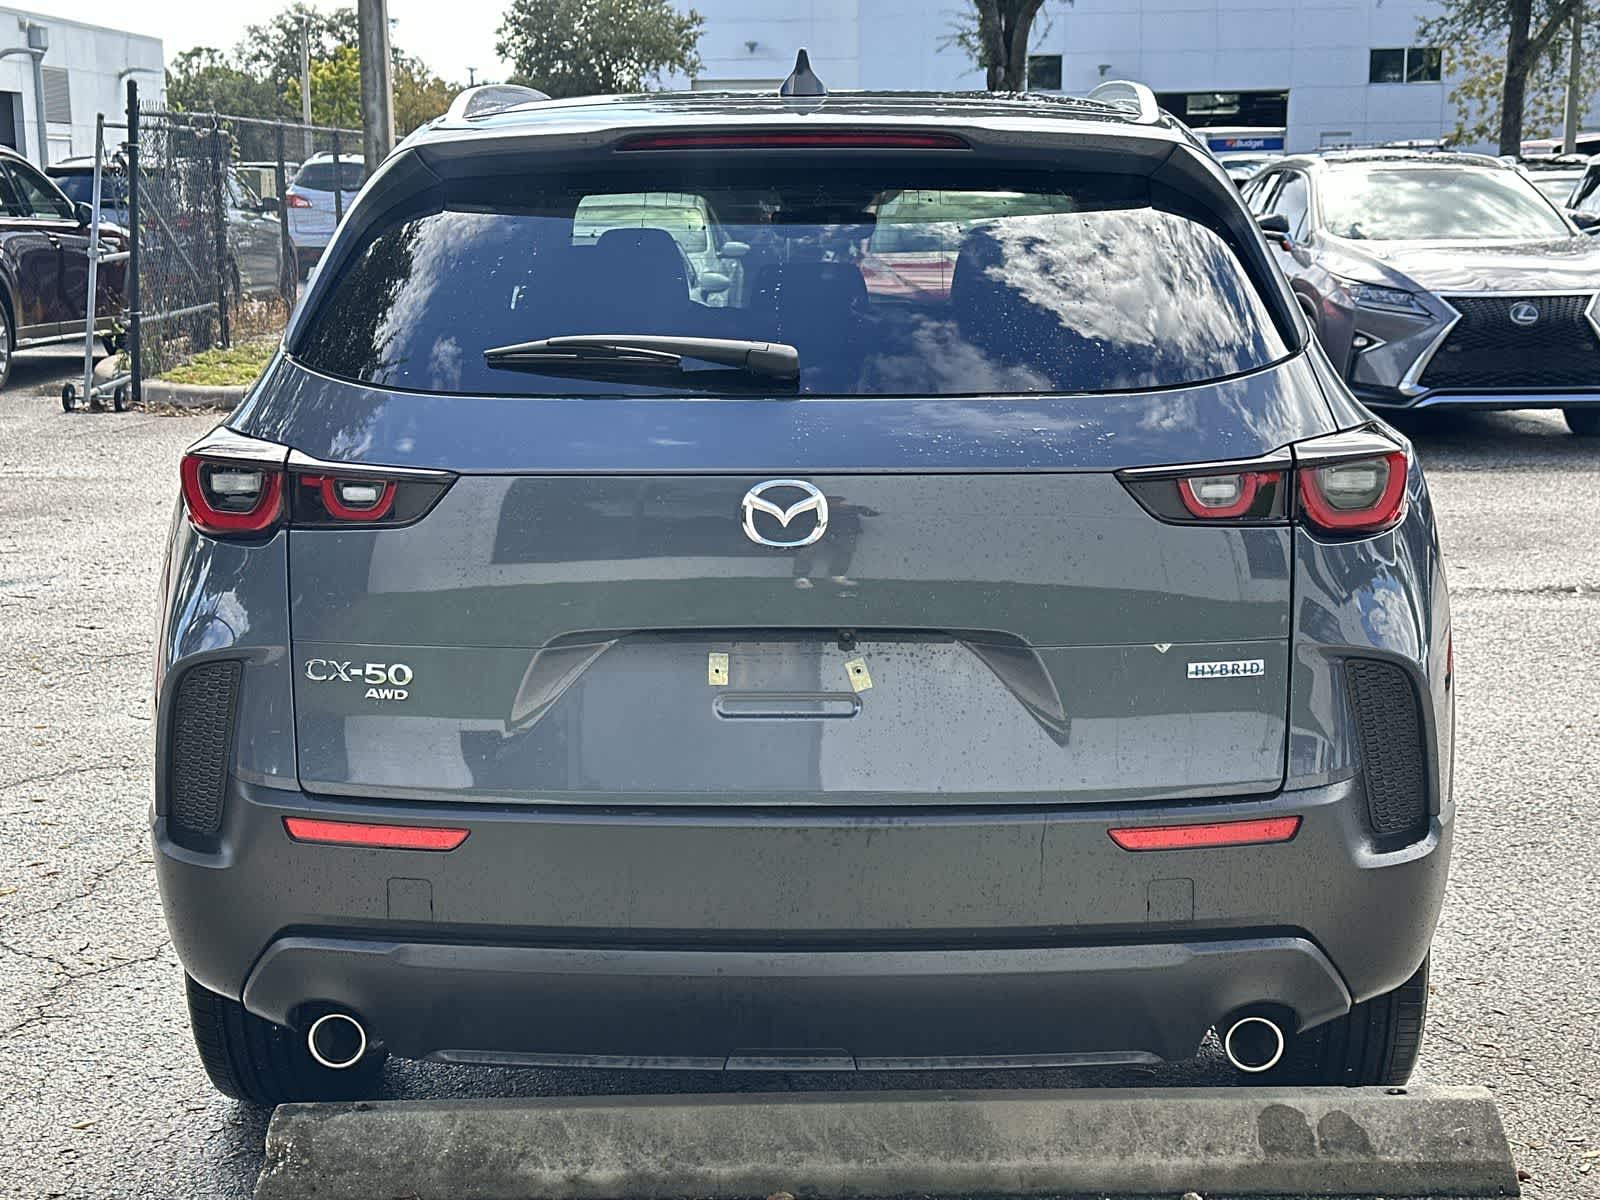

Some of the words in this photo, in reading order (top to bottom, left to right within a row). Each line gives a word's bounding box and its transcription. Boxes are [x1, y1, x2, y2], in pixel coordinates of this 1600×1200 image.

[1236, 139, 1264, 149] Budget
[304, 658, 413, 686] CX-50
[1194, 661, 1261, 677] HYBRID
[365, 687, 409, 700] AWD
